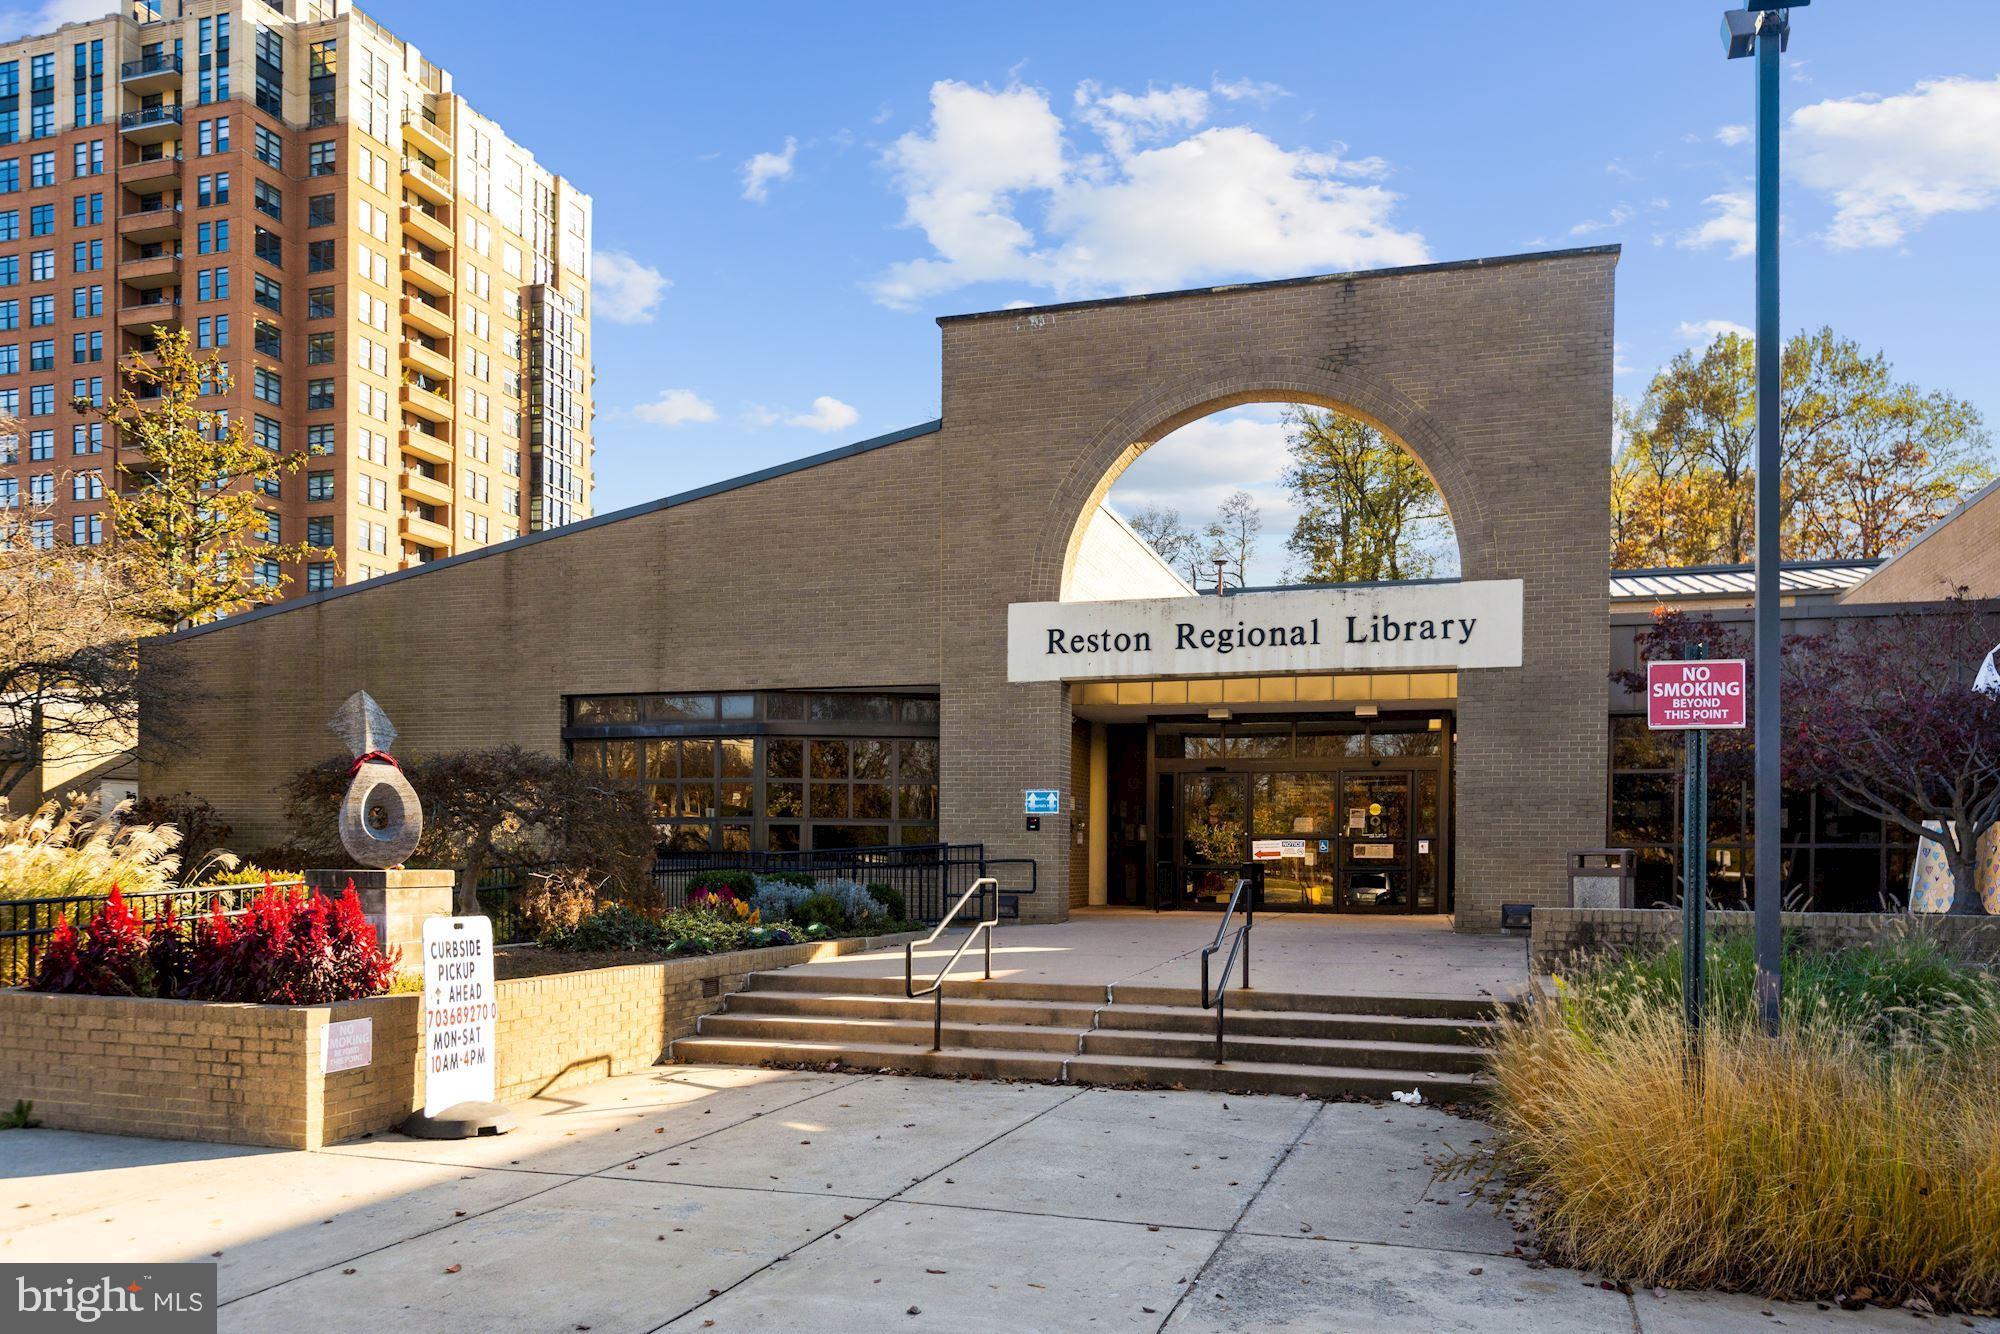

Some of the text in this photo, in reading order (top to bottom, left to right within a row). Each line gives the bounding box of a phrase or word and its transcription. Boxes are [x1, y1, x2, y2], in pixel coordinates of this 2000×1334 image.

[1046, 614, 1477, 655] Reston Regional Library
[1682, 667, 1710, 681] NO
[1653, 682, 1740, 697] SMOKING
[1672, 698, 1720, 708] BEYOND
[1664, 709, 1729, 719] THIS POINT
[430, 939, 481, 960] CURBSIDE
[438, 962, 475, 981] PICKUP
[449, 983, 482, 1003] AHEAD
[340, 1023, 354, 1036] NO
[433, 1026, 481, 1050] MON-SAT
[327, 1033, 369, 1049] MOKING
[431, 1049, 486, 1073] 10AM-4PM
